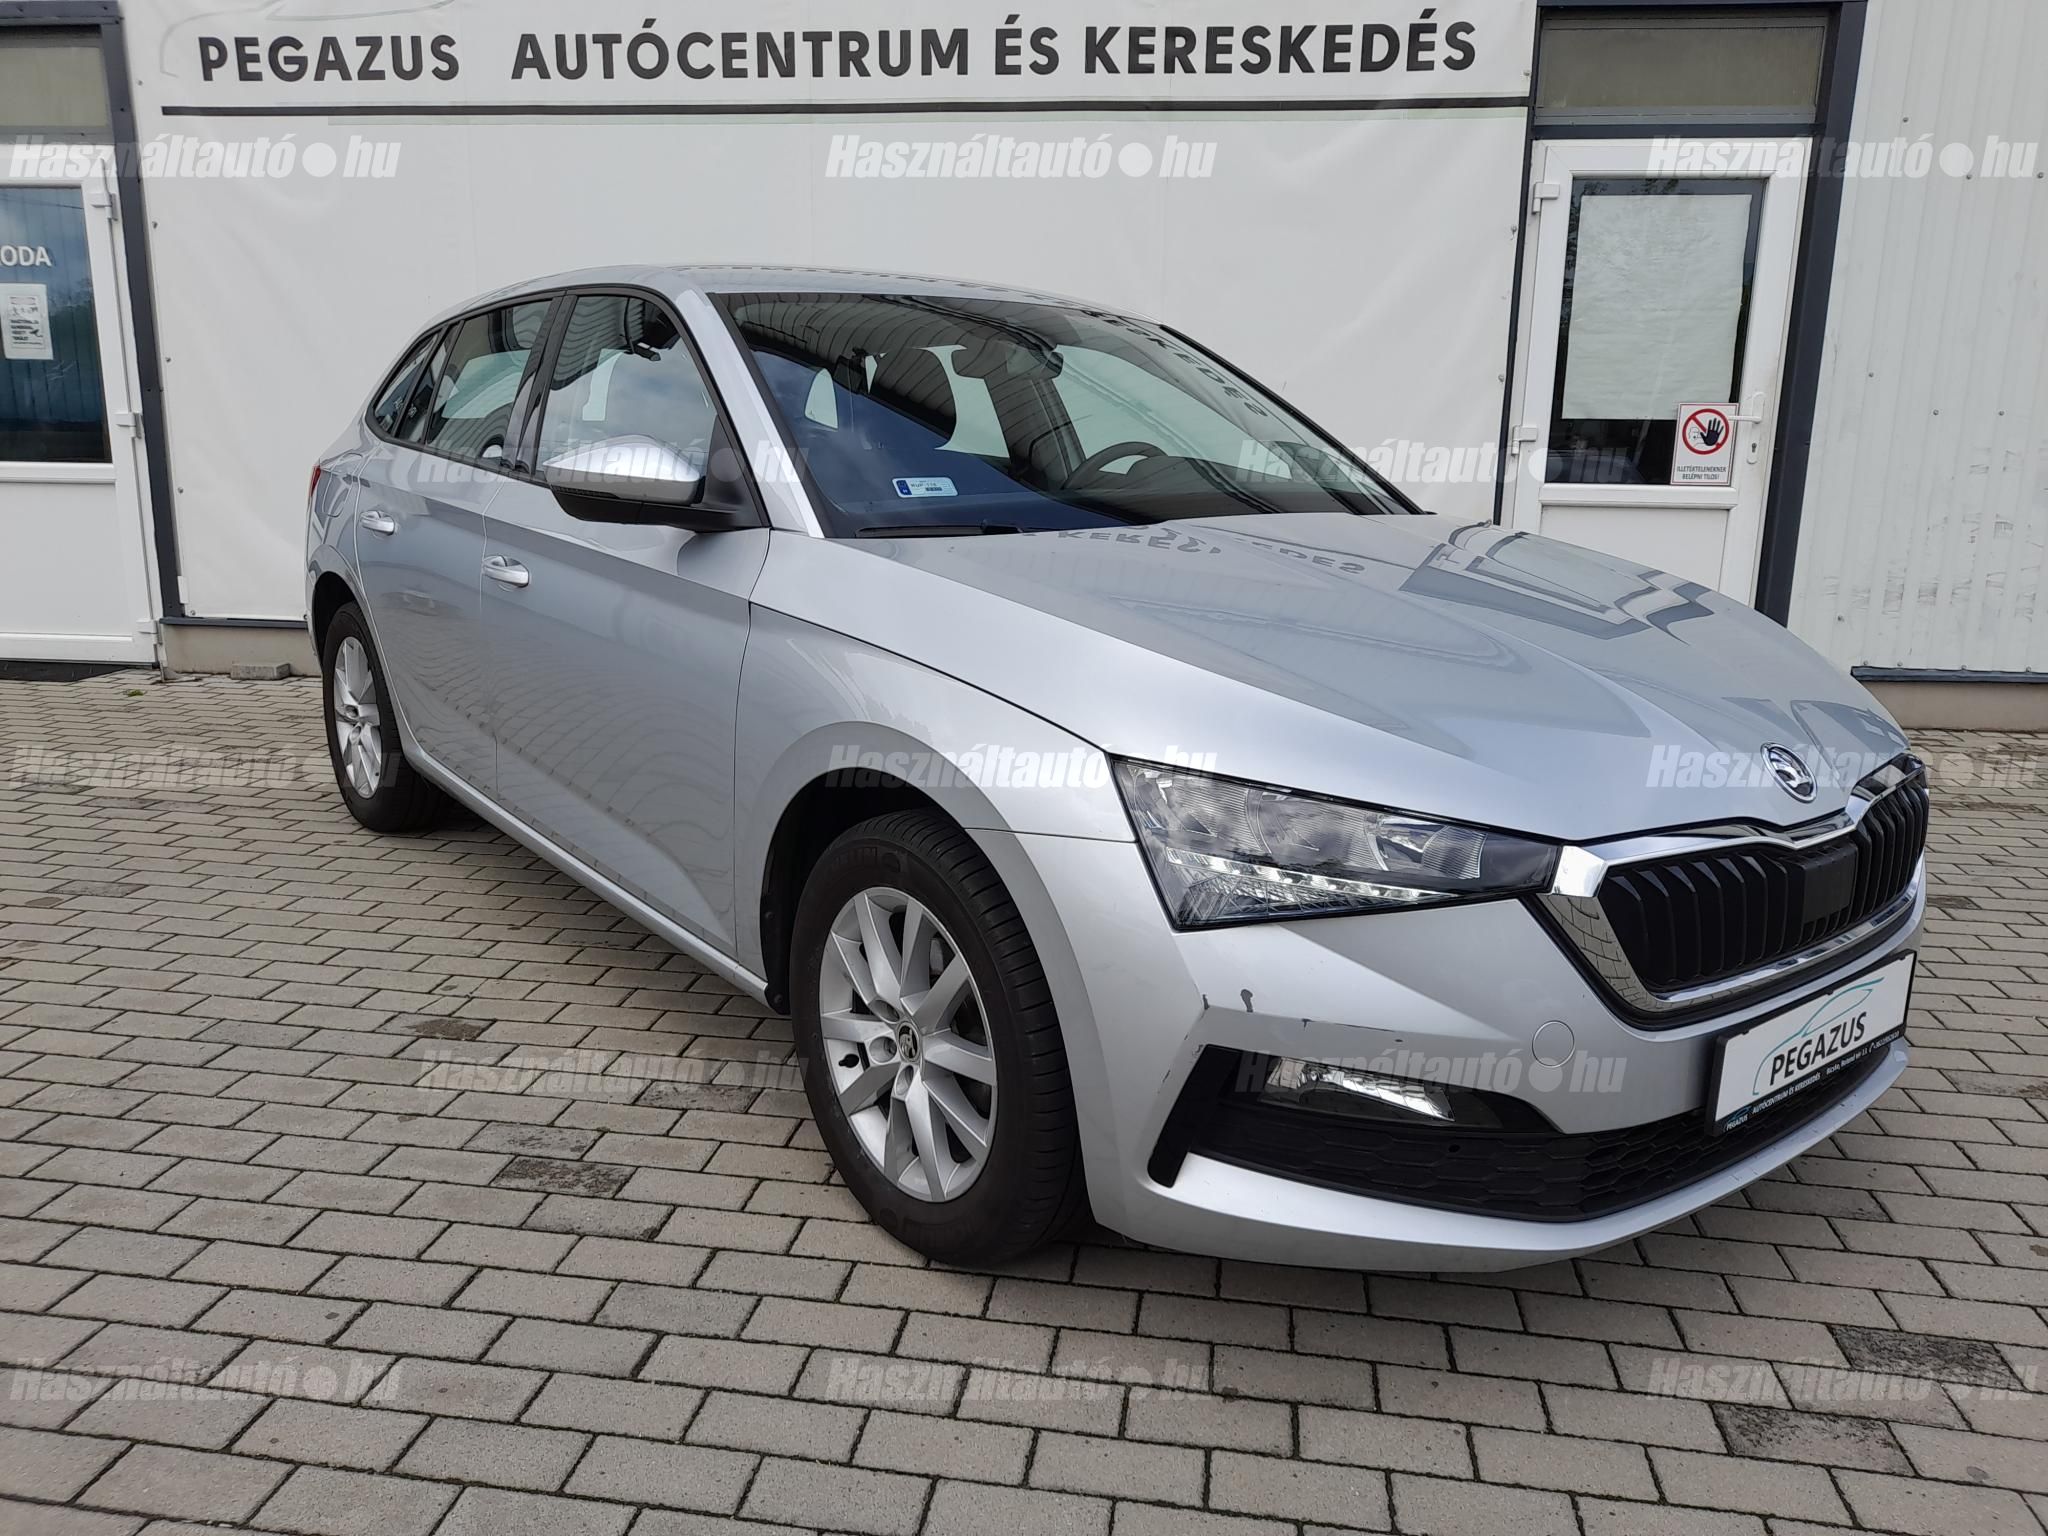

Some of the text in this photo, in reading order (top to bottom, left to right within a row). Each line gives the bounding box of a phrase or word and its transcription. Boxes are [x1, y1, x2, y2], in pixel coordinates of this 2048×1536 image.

[198, 8, 1476, 82] PEGAZUS AUTÓCENTRUM ÉS KERESKEDÉS
[0, 245, 52, 266] ODA
[1769, 1011, 1867, 1086] PEGAZUS
[1726, 1114, 1748, 1131] PEGAZUS
